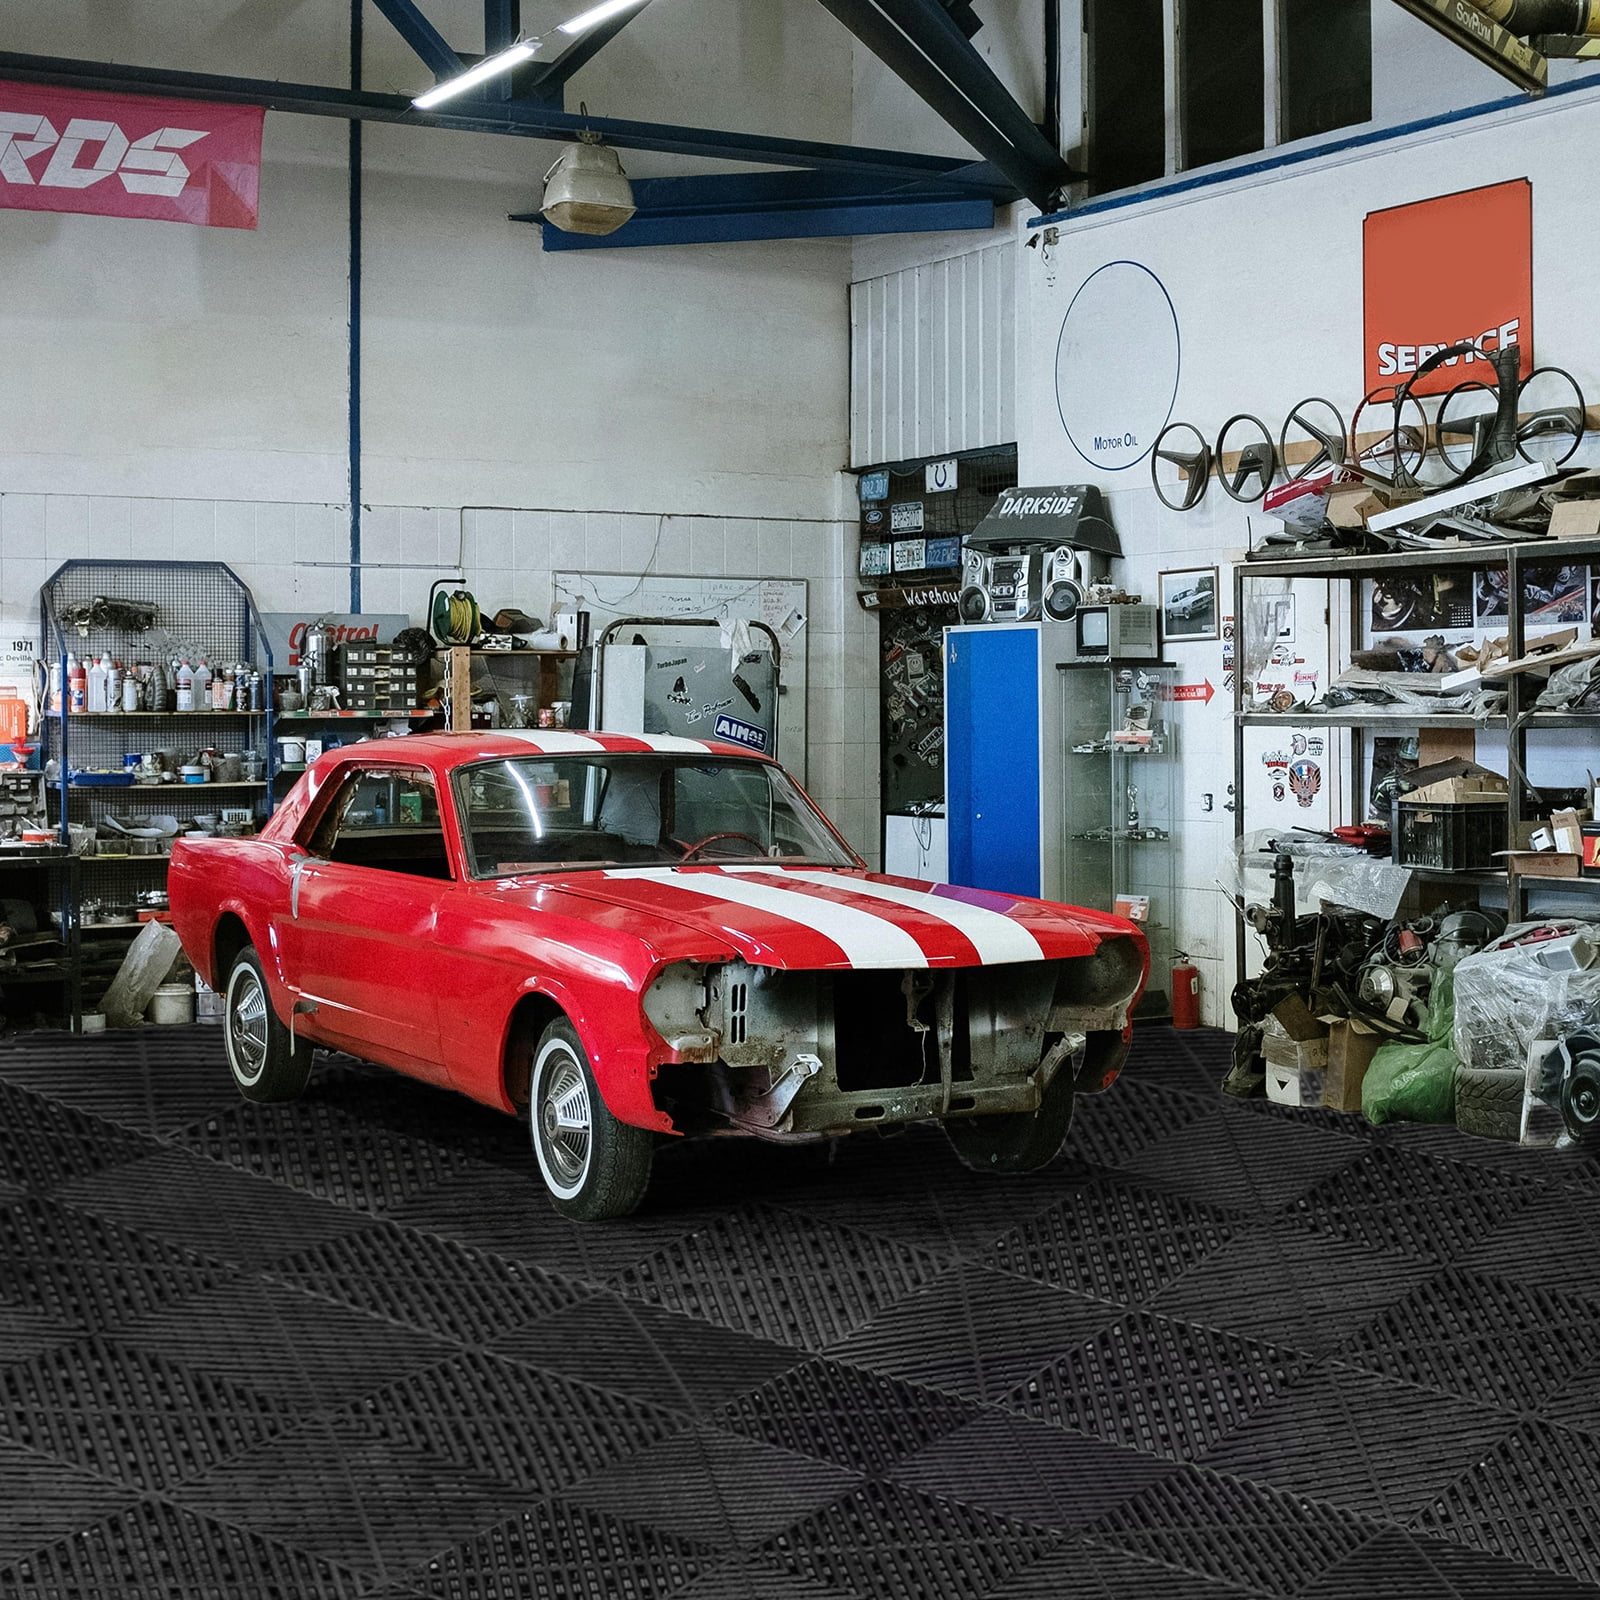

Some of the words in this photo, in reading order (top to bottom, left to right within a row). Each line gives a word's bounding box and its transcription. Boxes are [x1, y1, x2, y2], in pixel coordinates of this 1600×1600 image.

[1000, 496, 1078, 514] DARKSIDE
[902, 586, 962, 606] Warehou
[12, 640, 33, 651] 1971
[289, 622, 380, 650] Cstrol
[716, 720, 763, 743] AIMOL
